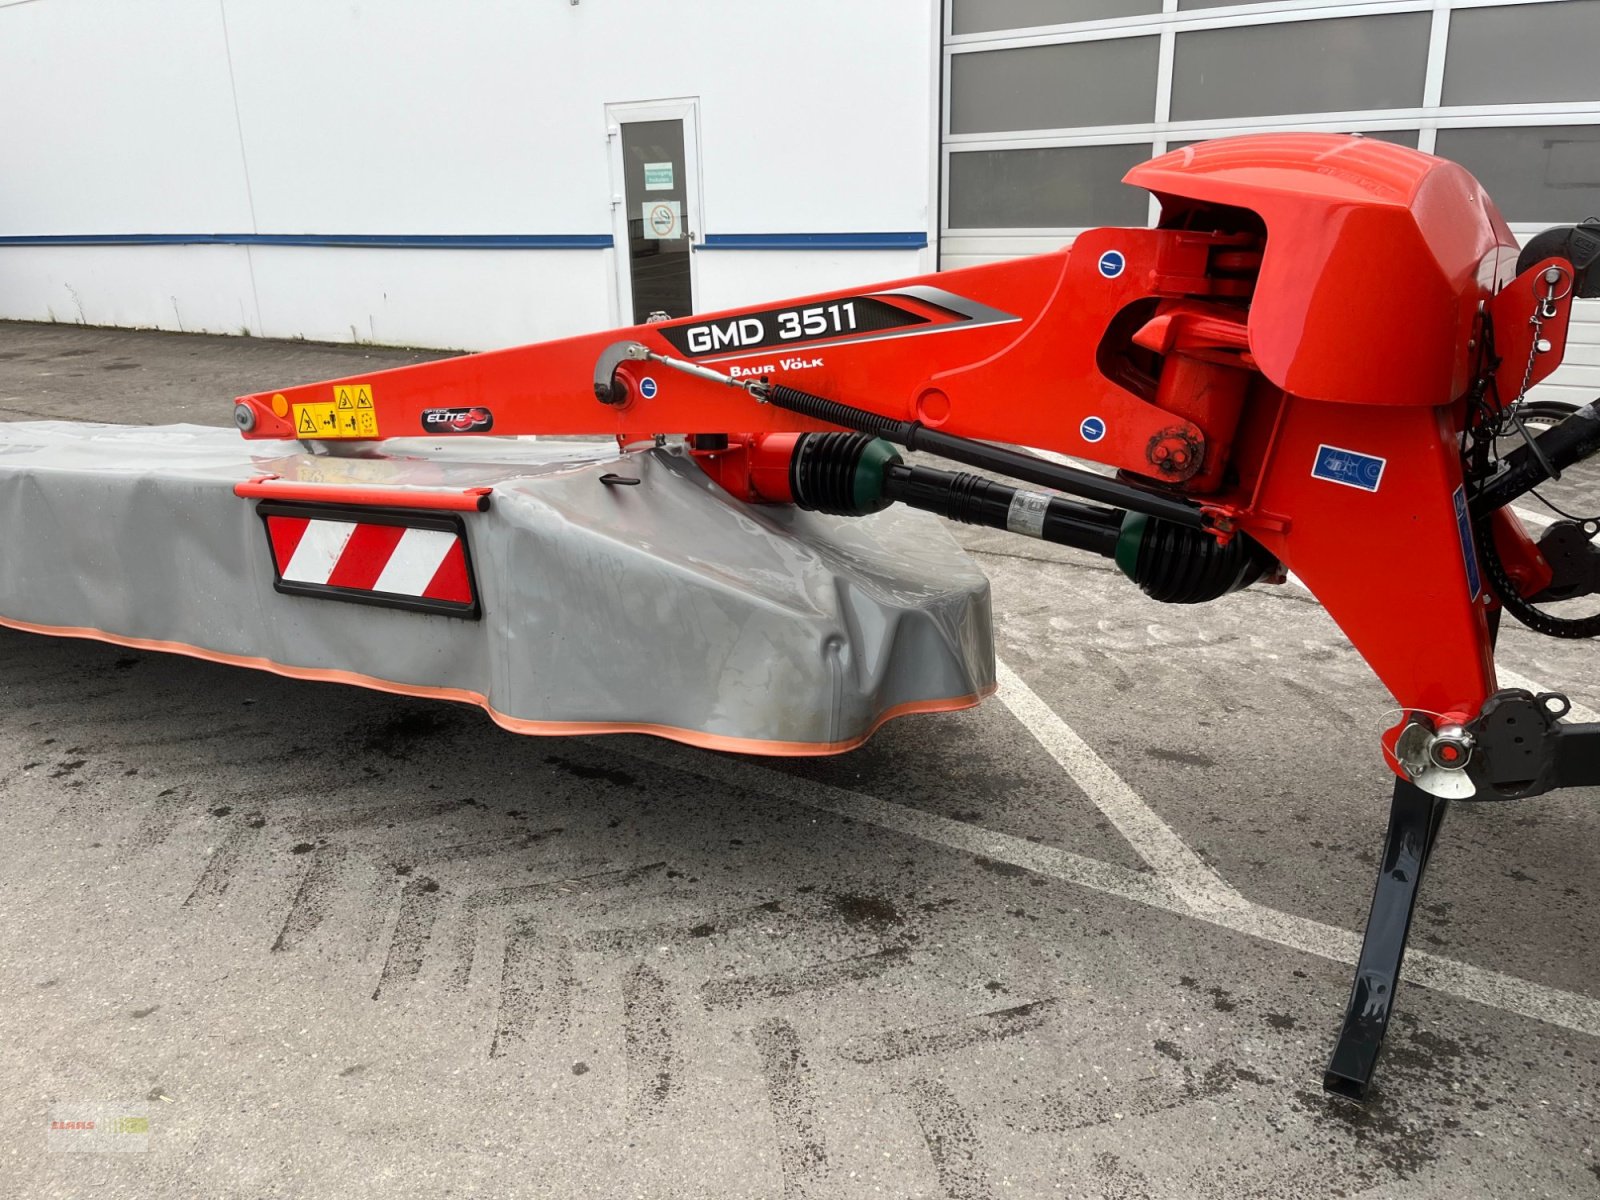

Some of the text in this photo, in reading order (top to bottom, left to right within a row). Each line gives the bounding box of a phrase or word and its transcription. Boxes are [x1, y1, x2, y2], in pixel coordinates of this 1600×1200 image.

[687, 302, 857, 353] GMD 3511
[730, 358, 824, 378] BAUR VÖLK
[427, 413, 467, 423] ELITE
